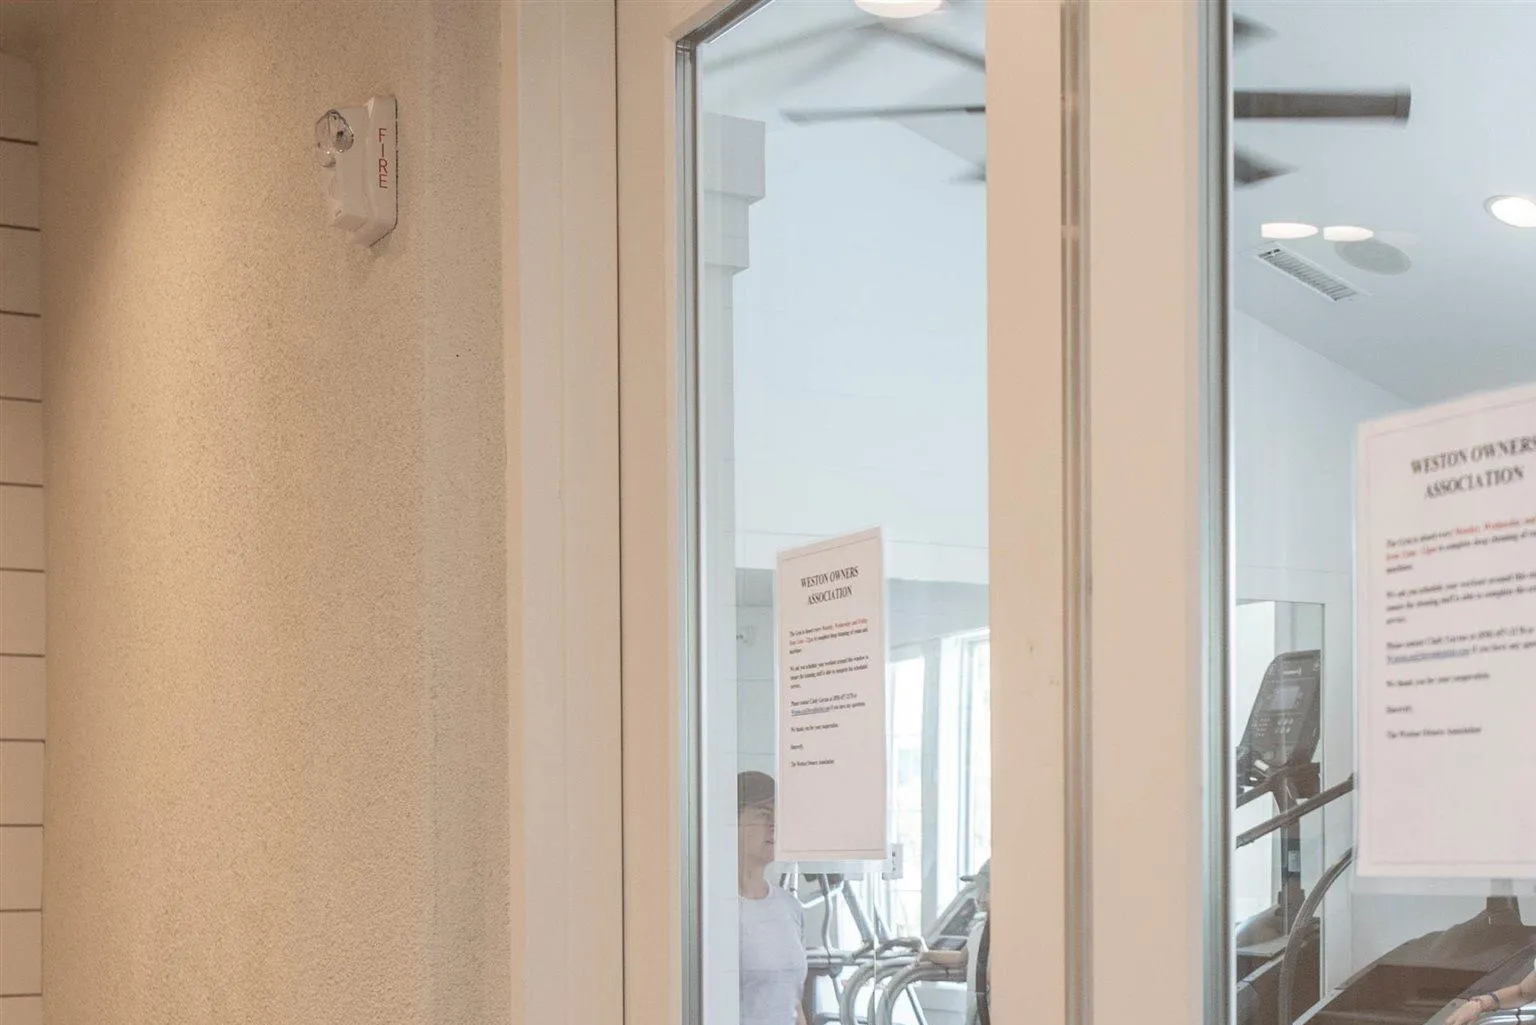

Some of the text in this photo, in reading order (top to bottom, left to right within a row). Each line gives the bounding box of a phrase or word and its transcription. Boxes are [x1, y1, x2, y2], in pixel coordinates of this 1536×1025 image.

[378, 128, 388, 189] FIRE
[1410, 448, 1469, 474] WESTON
[1425, 466, 1525, 499] ASSOCIATION
[800, 565, 860, 589] WESTON OWNERS
[807, 584, 853, 606] ASSOCIATION
